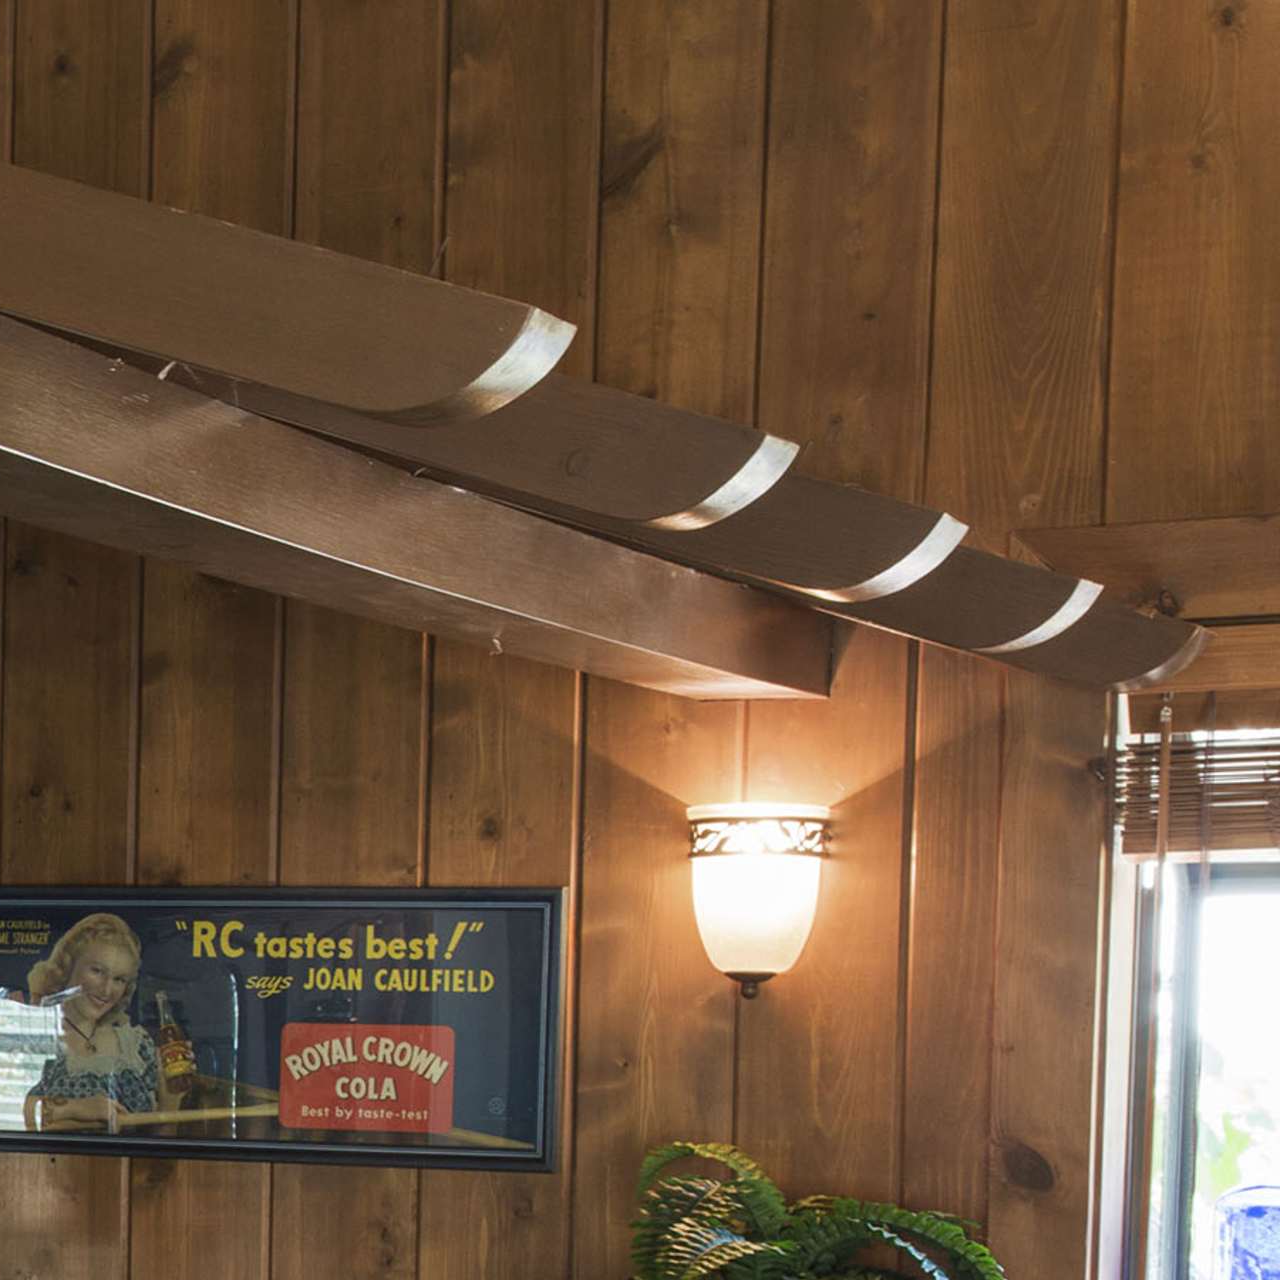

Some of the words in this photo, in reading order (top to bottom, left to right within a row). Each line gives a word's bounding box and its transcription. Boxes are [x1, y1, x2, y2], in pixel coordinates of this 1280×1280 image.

[175, 920, 245, 958] "RC
[254, 932, 353, 959] tastes
[245, 975, 294, 998] says
[303, 967, 363, 991] JOAN
[374, 968, 495, 993] CAULFIELD
[285, 1036, 358, 1081] ROYAL
[362, 1036, 448, 1084] CROWN
[335, 1076, 397, 1100] COLA
[301, 1105, 330, 1118] Best
[335, 1106, 352, 1120] by
[358, 1108, 428, 1120] taste-test
